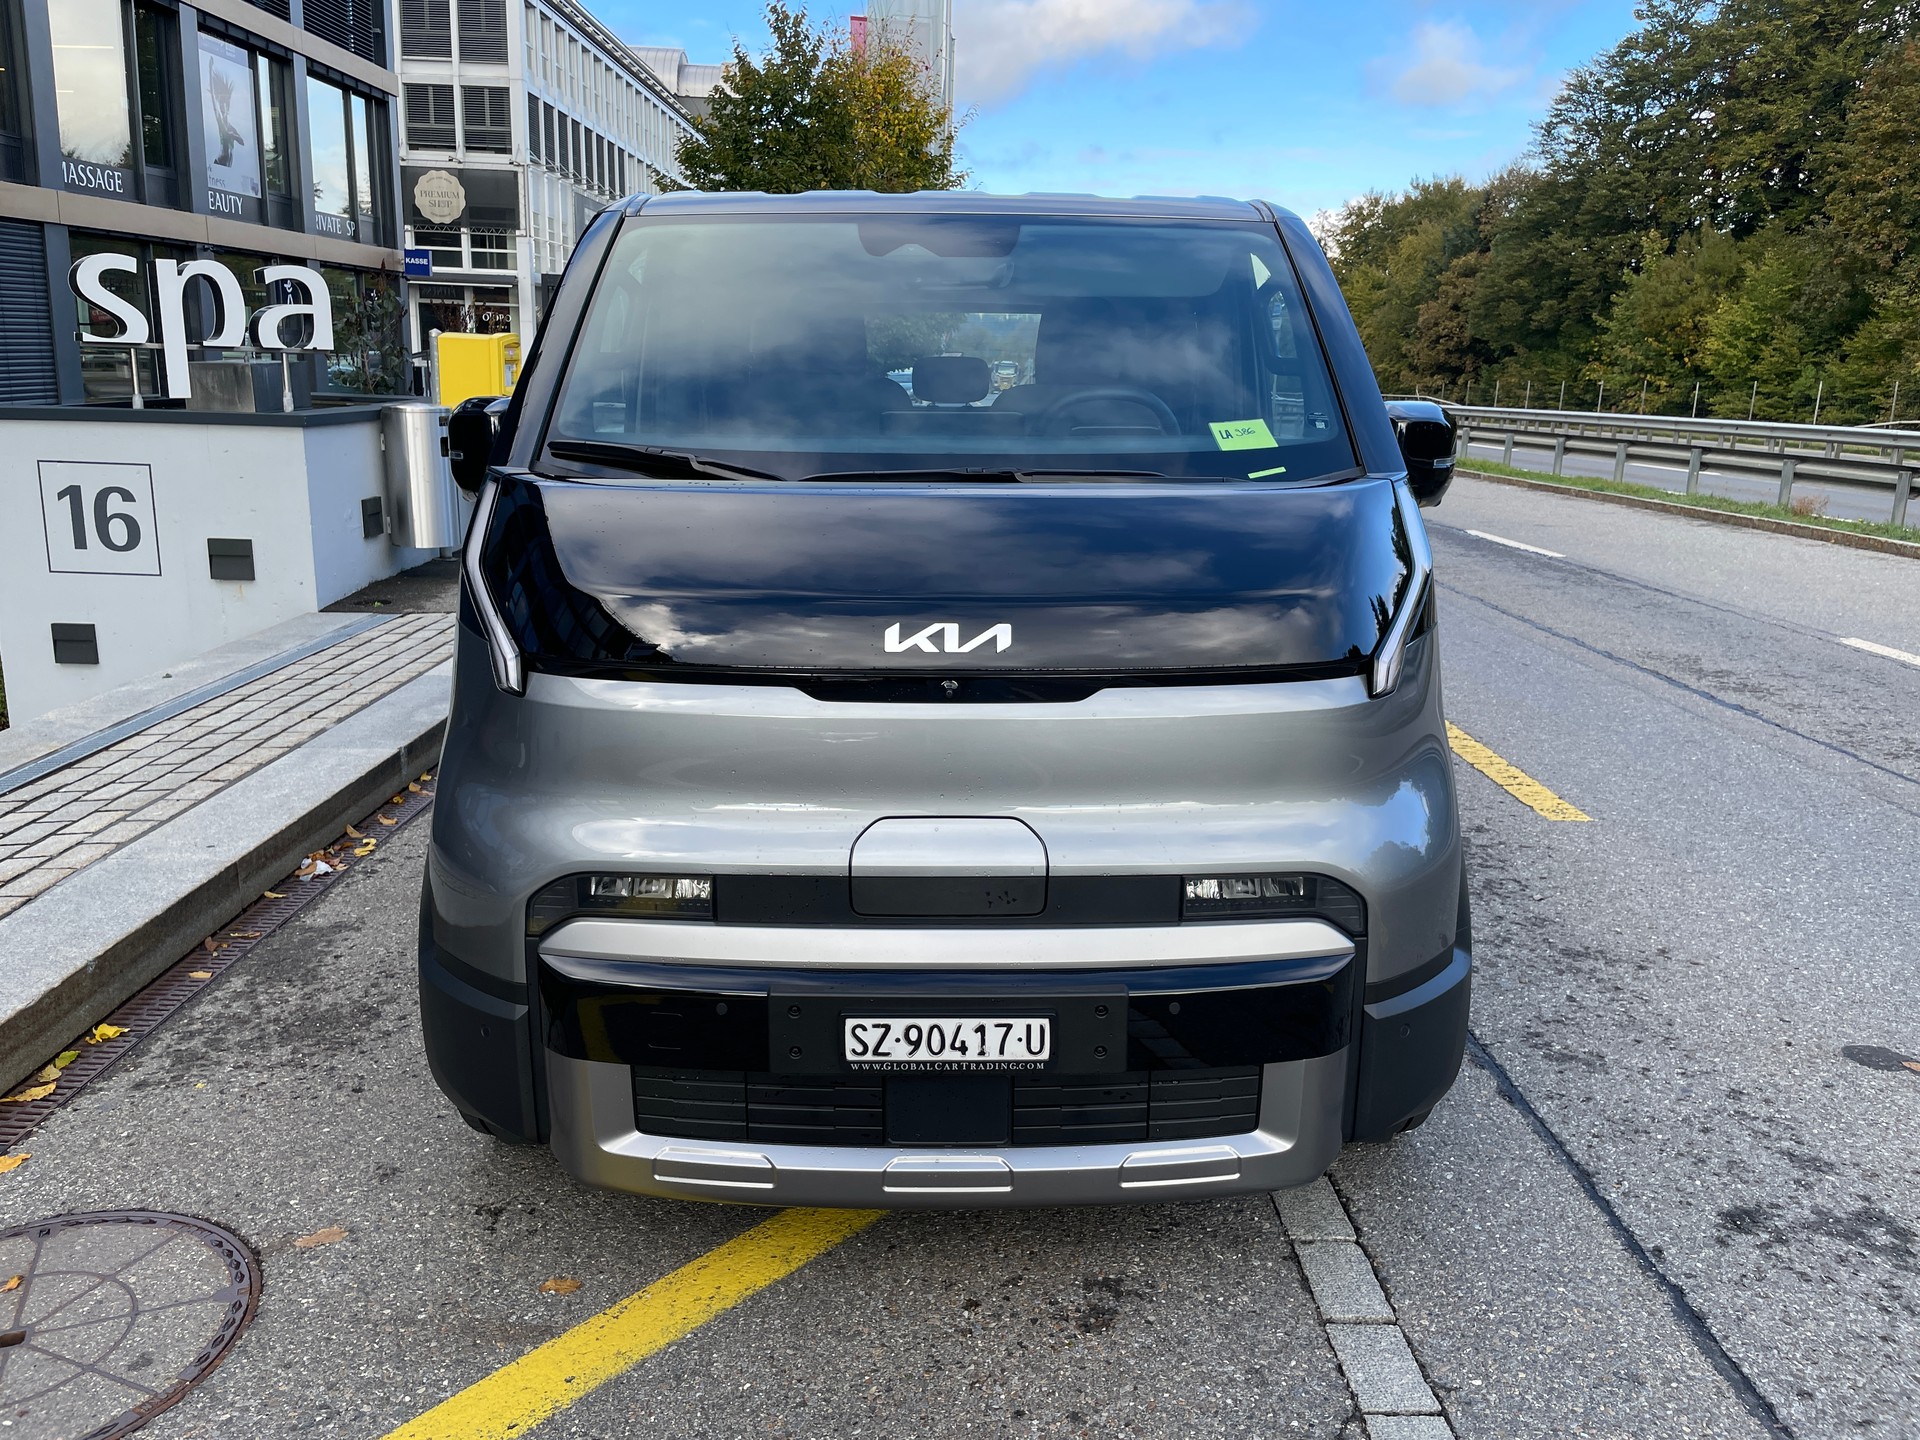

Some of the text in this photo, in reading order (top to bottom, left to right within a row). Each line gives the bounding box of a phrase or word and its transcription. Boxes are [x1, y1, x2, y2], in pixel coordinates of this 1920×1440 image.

[420, 190, 460, 200] PREMIUM
[405, 257, 429, 265] KASSE
[69, 253, 334, 398] spa
[1218, 429, 1234, 440] LA
[57, 484, 142, 552] 16
[884, 622, 1012, 653] KIA
